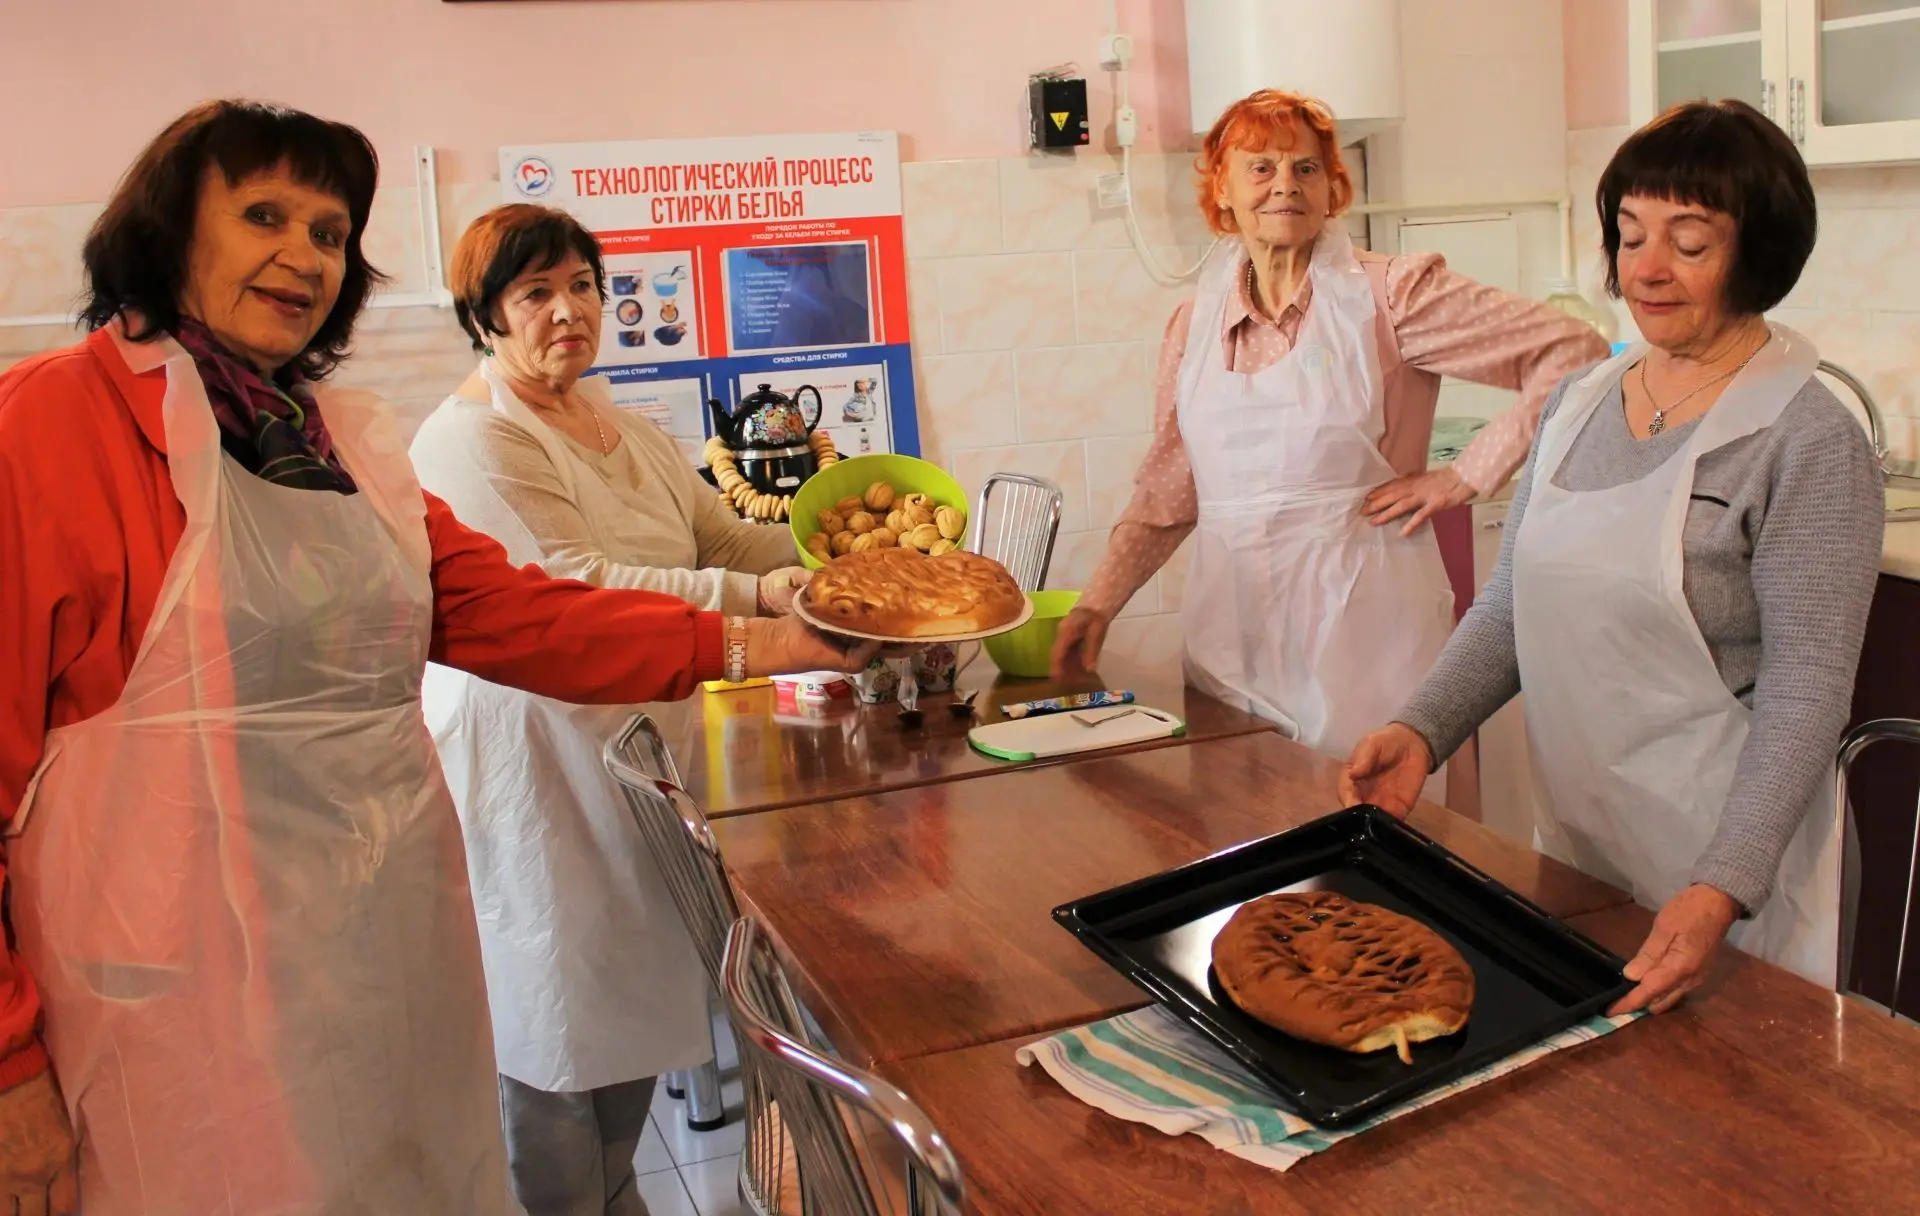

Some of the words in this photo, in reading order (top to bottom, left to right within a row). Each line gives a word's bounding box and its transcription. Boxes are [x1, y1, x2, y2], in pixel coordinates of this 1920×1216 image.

[571, 156, 778, 197] ТЕХНОЛОГИЧЕСКИЙ
[783, 156, 873, 187] ПРОЦЕСС
[651, 194, 732, 224] СТИРКИ
[737, 190, 804, 219] БЕЛЬЯ
[773, 355, 806, 364] СРЕДСТВА
[806, 354, 821, 362] ДЛЯ
[822, 352, 848, 360] СТИРКИ
[631, 367, 658, 375] СТИРКИ
